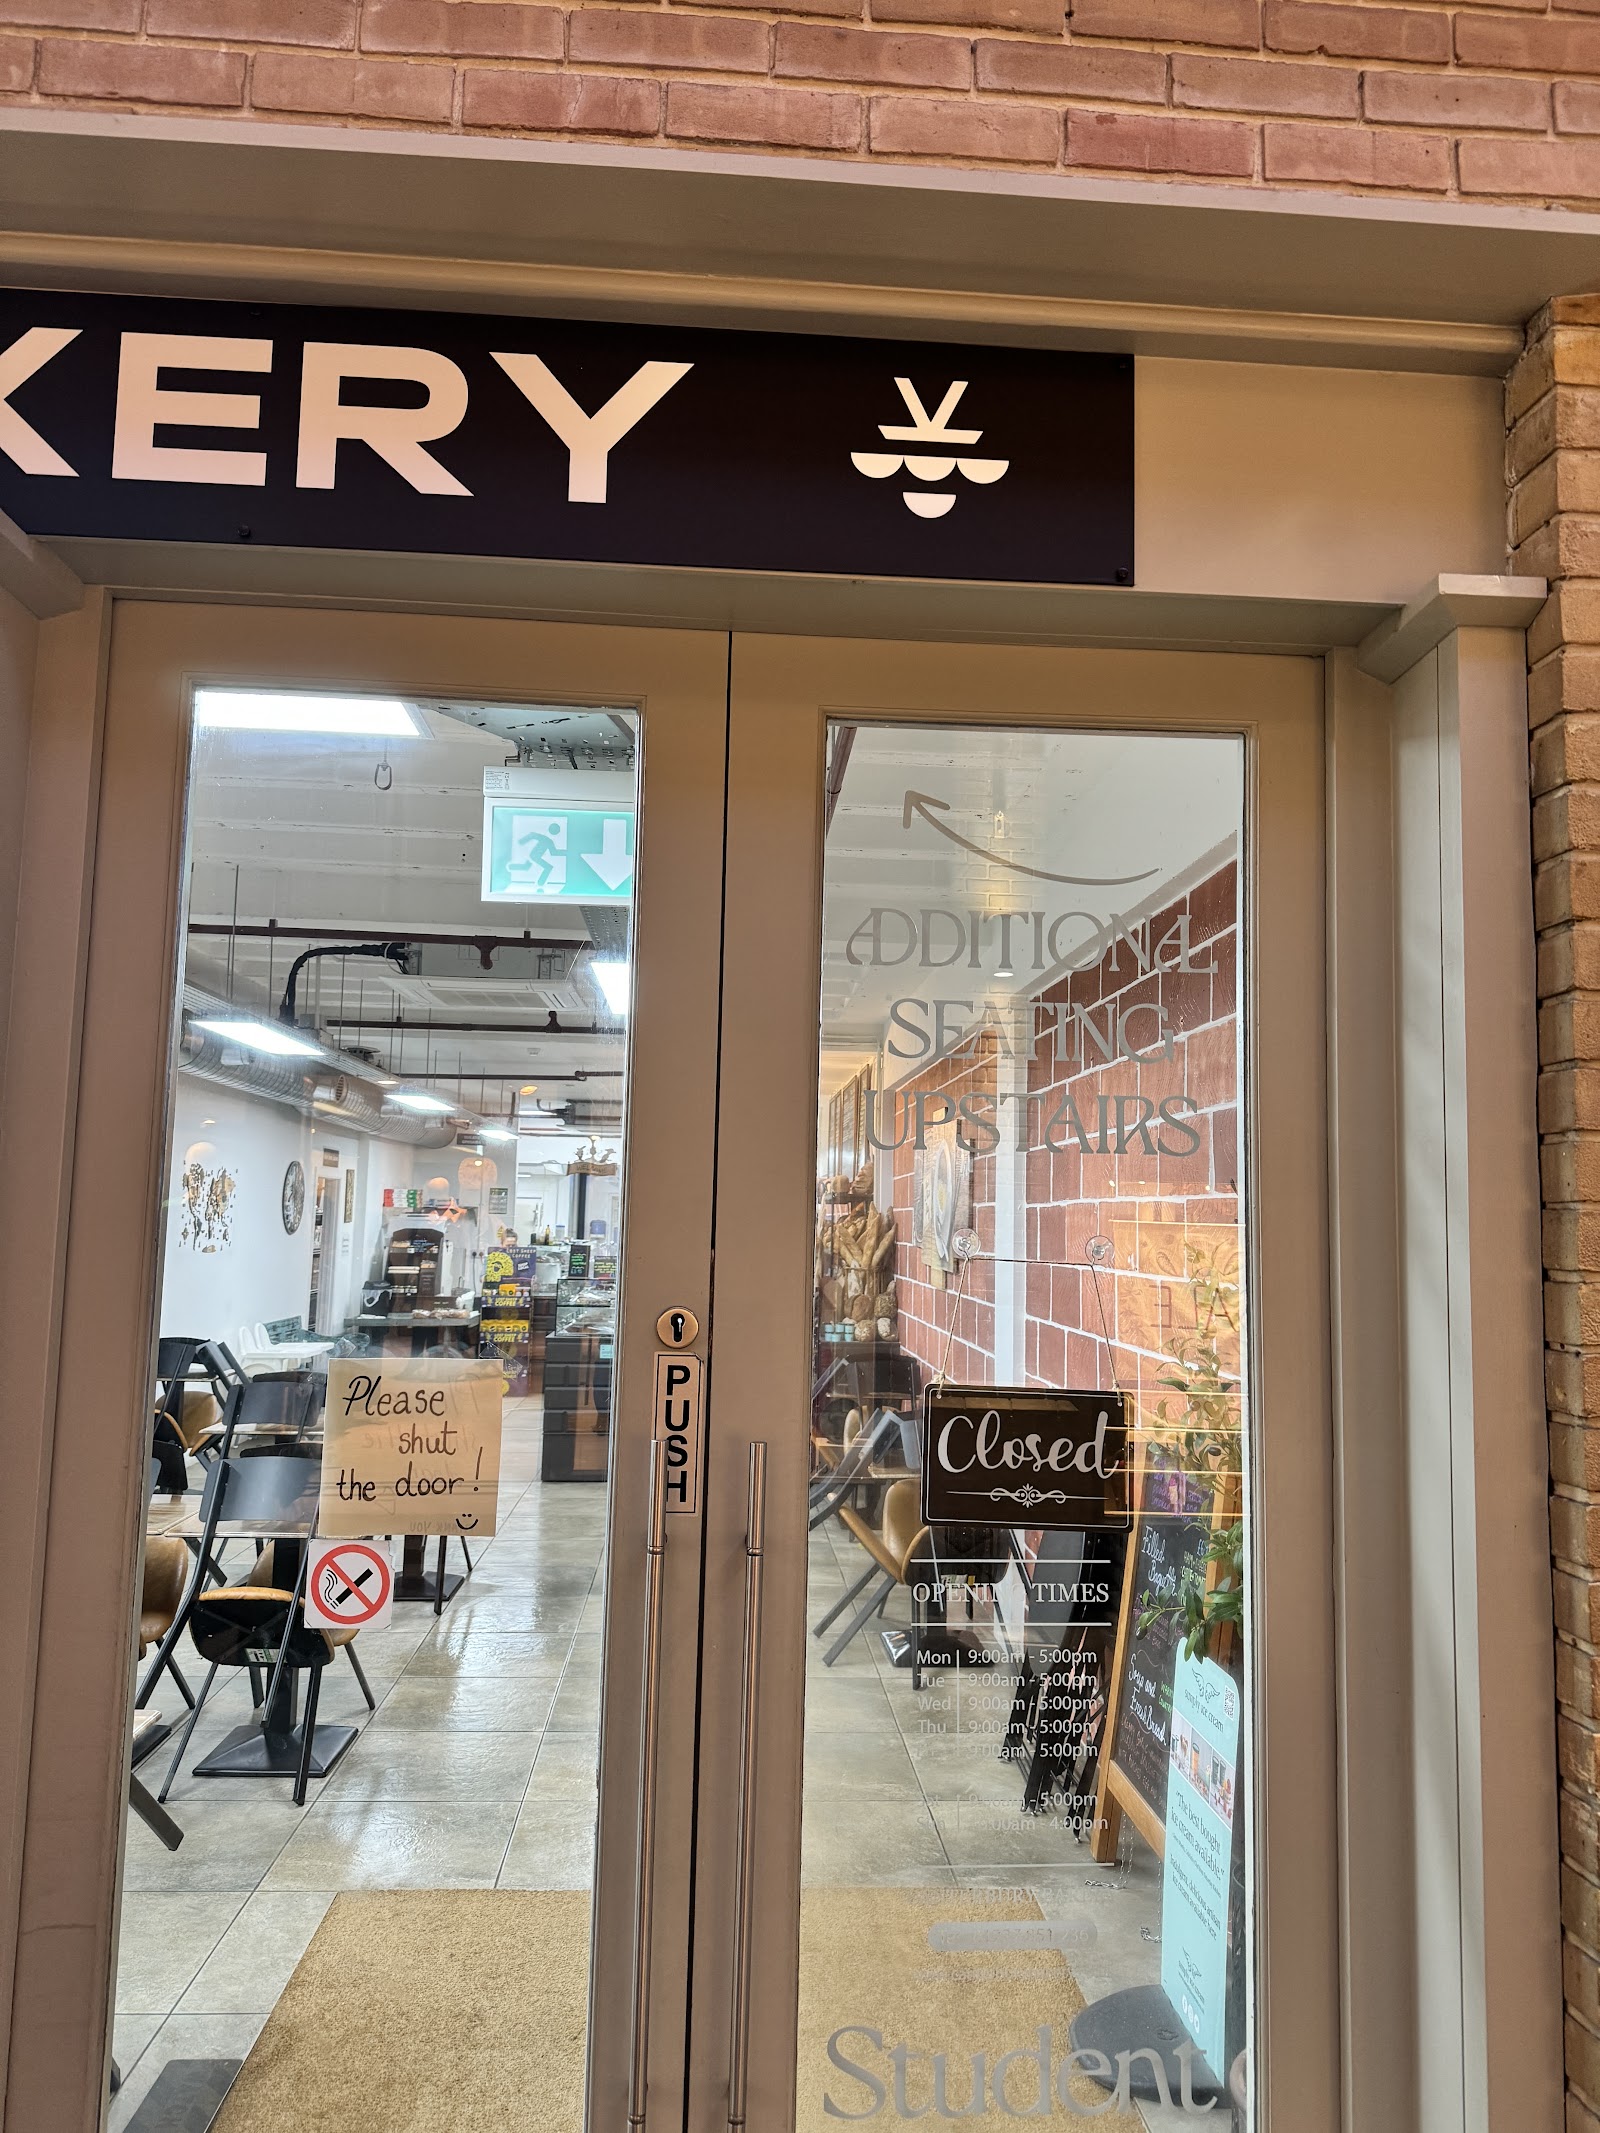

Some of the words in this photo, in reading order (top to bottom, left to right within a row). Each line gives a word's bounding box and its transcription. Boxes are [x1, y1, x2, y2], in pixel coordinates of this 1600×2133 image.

[846, 907, 1218, 974] ADDITIONAL
[888, 997, 1174, 1064] SEATING
[864, 1089, 1201, 1157] UPSTAIRS
[342, 1375, 445, 1416] Please
[398, 1420, 458, 1455] shut
[665, 1365, 691, 1503] PUSH
[937, 1410, 1119, 1480] Closed
[336, 1468, 376, 1501] the
[1032, 1582, 1109, 1603] TIMES
[916, 1650, 951, 1665] Mon
[968, 1649, 1025, 1664] 9:00am
[1039, 1649, 1097, 1666] 5:00pm
[917, 1673, 945, 1688] Tue
[968, 1673, 1025, 1687] 9:00am
[1039, 1673, 1097, 1690] 5:00pm
[917, 1696, 951, 1710] Wed
[968, 1696, 1025, 1710] 9:00am
[1039, 1696, 1097, 1714] 5:00pm
[917, 1719, 946, 1734] Thu
[968, 1720, 1025, 1734] 9:00am
[1039, 1720, 1097, 1738] 5:00pm
[1039, 1743, 1098, 1760] 5:00pm
[1040, 1791, 1098, 1810] 5:00pm
[1049, 1816, 1108, 1833] 4:00pm
[1201, 1817, 1220, 1855] bought
[824, 2025, 1218, 2121] Student
